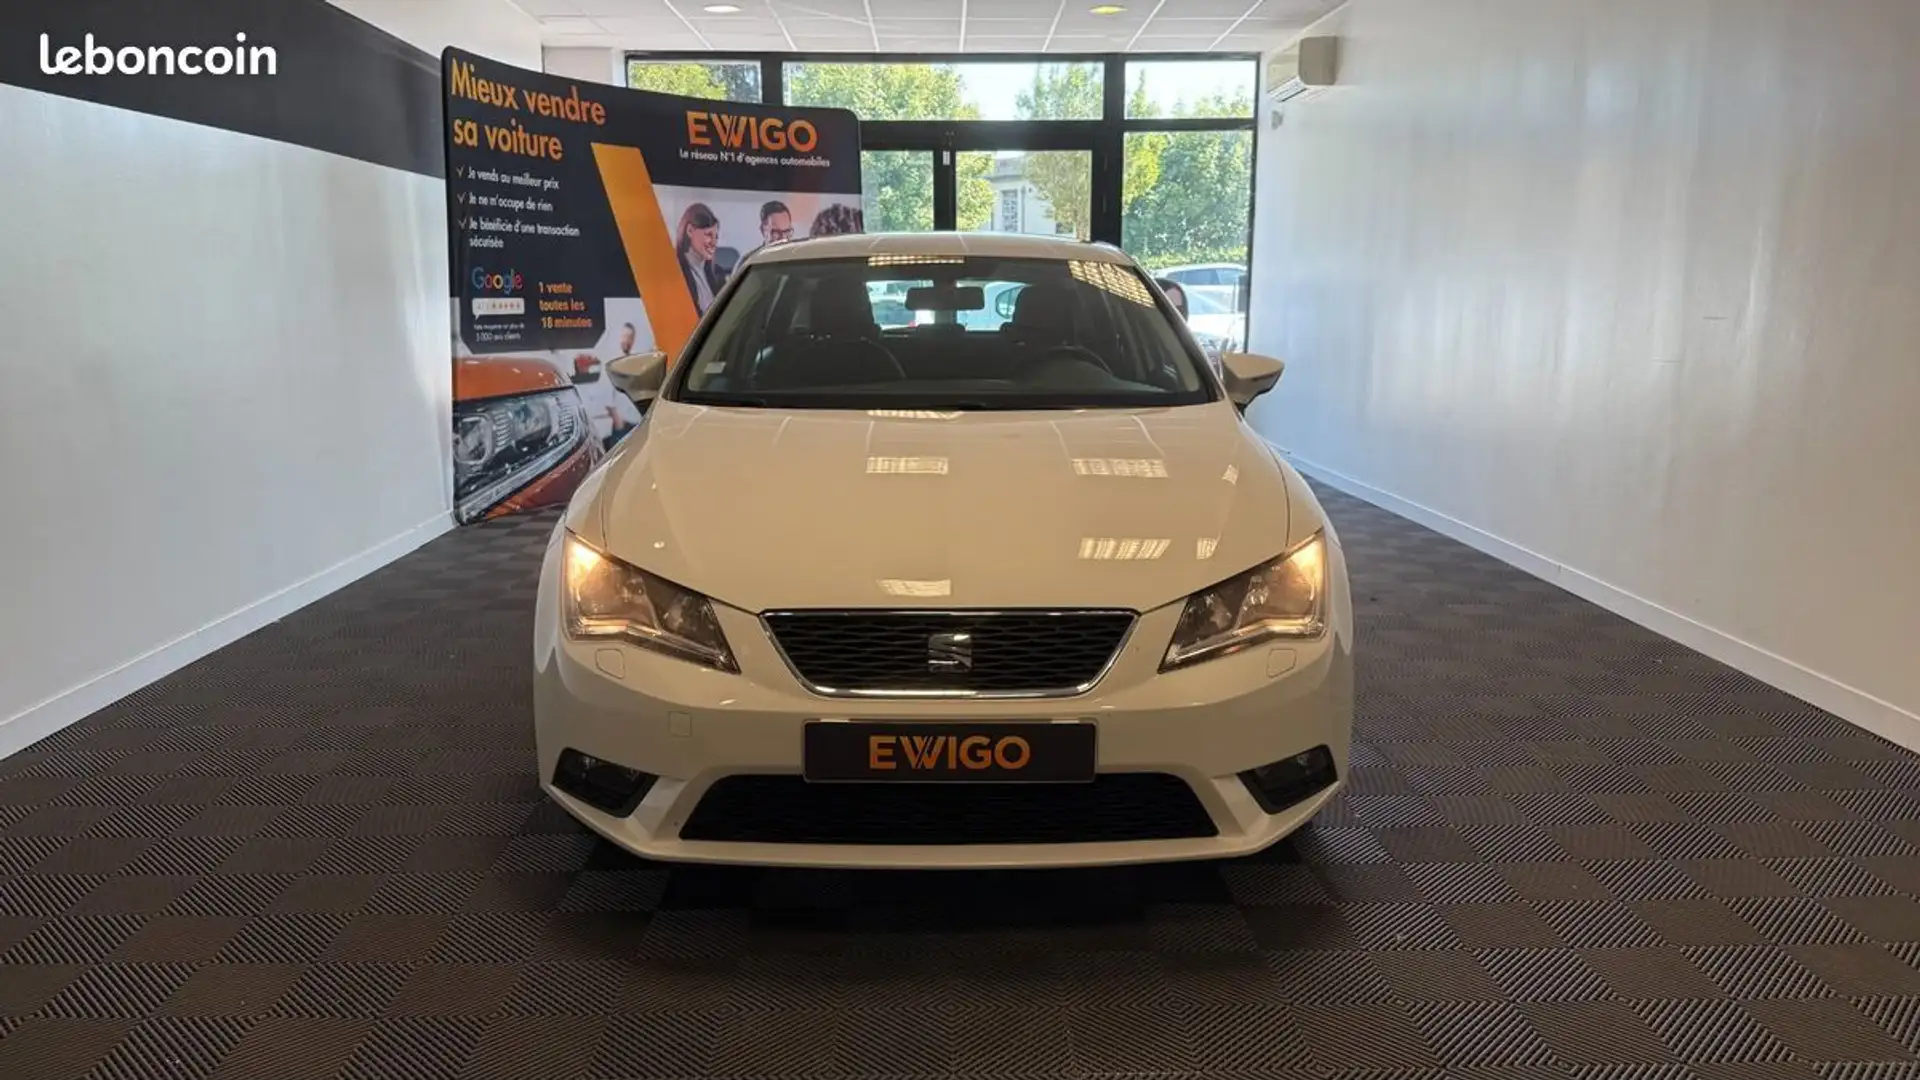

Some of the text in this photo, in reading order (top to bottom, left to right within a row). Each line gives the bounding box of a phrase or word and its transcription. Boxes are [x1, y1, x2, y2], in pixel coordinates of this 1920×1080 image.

[452, 58, 607, 126] Mieux vendre
[453, 117, 563, 160] sa voiture
[686, 110, 818, 152] EWIGO
[680, 149, 689, 159] Le
[691, 150, 718, 161] réseau
[737, 153, 779, 166] d'agences
[781, 157, 831, 167] automobiles
[468, 166, 560, 191] Je vends au meilleur prix
[469, 192, 553, 212] Je ne m'occupe de rien
[469, 216, 478, 230] Je
[536, 223, 580, 237] transaction
[472, 267, 524, 296] Google
[538, 281, 573, 294] 1 vente
[539, 297, 585, 311] toutes les
[541, 315, 593, 329] 18 minutes
[869, 735, 1031, 769] EWIGO
